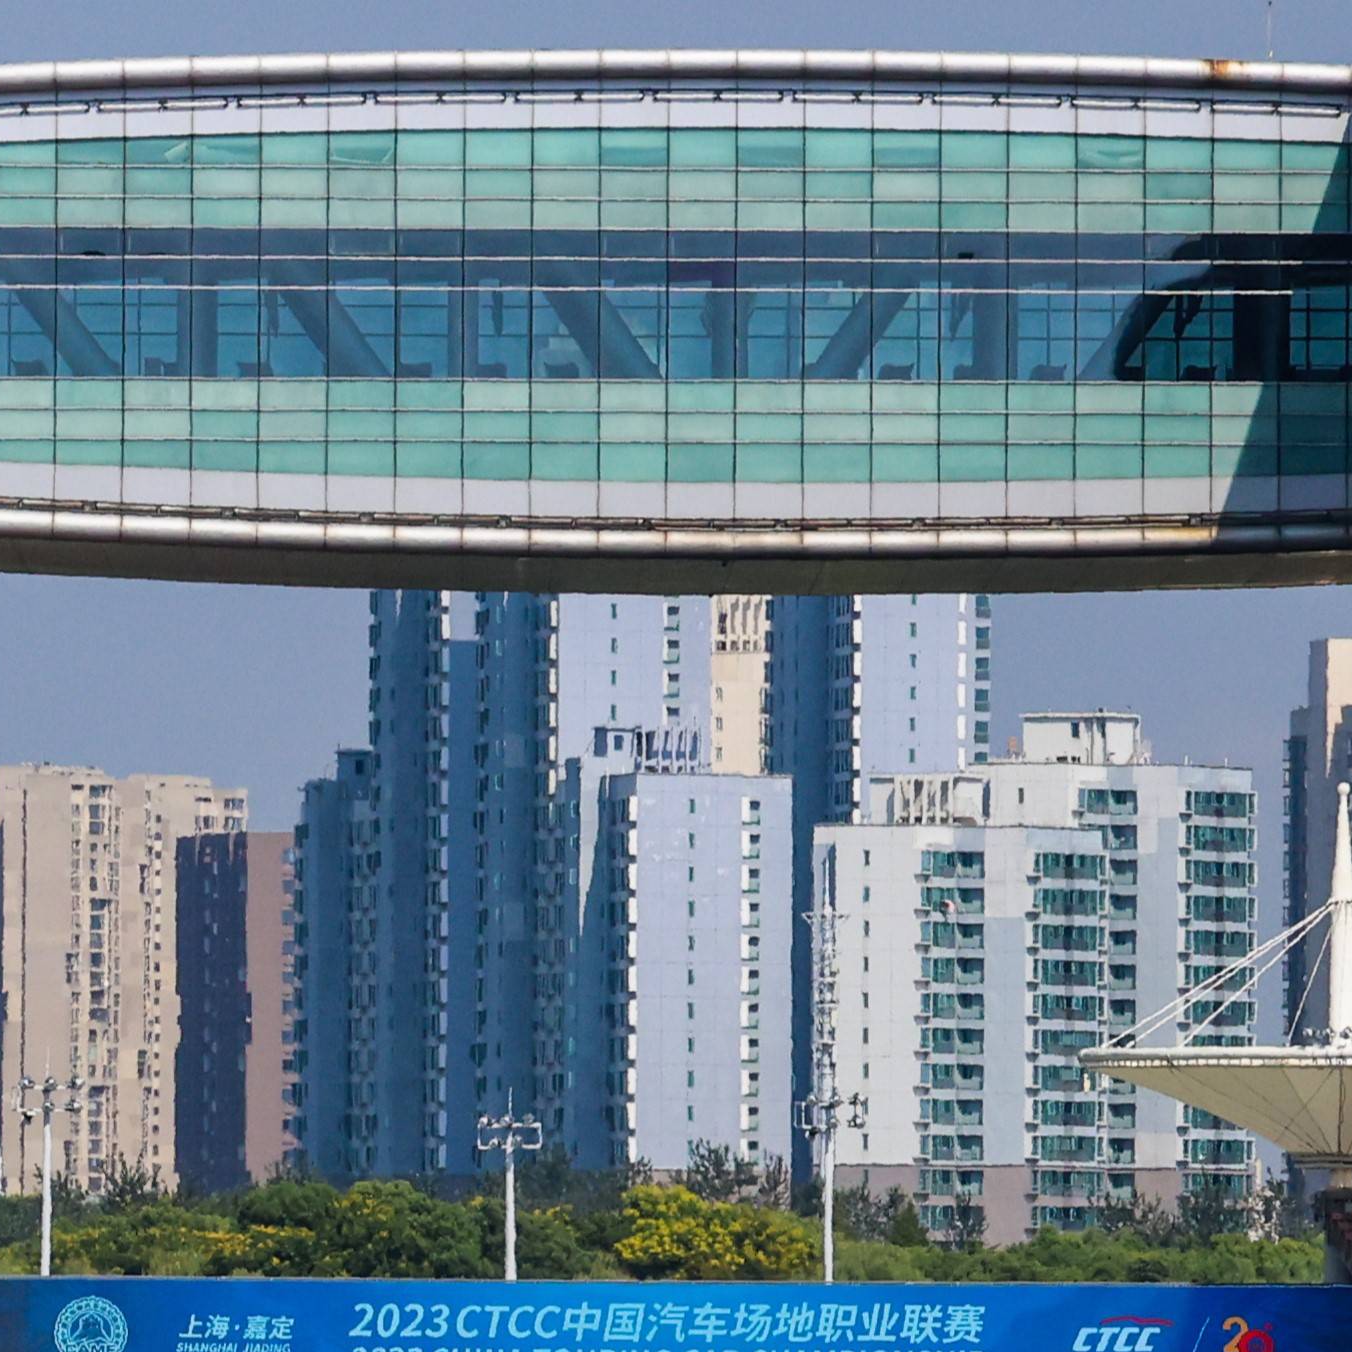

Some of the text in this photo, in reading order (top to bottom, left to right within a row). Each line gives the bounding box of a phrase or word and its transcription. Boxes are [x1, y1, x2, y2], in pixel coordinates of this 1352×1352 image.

[178, 1314, 295, 1340] 上海·嘉定
[348, 1303, 450, 1338] 2023
[1072, 1326, 1161, 1352] CTCC
